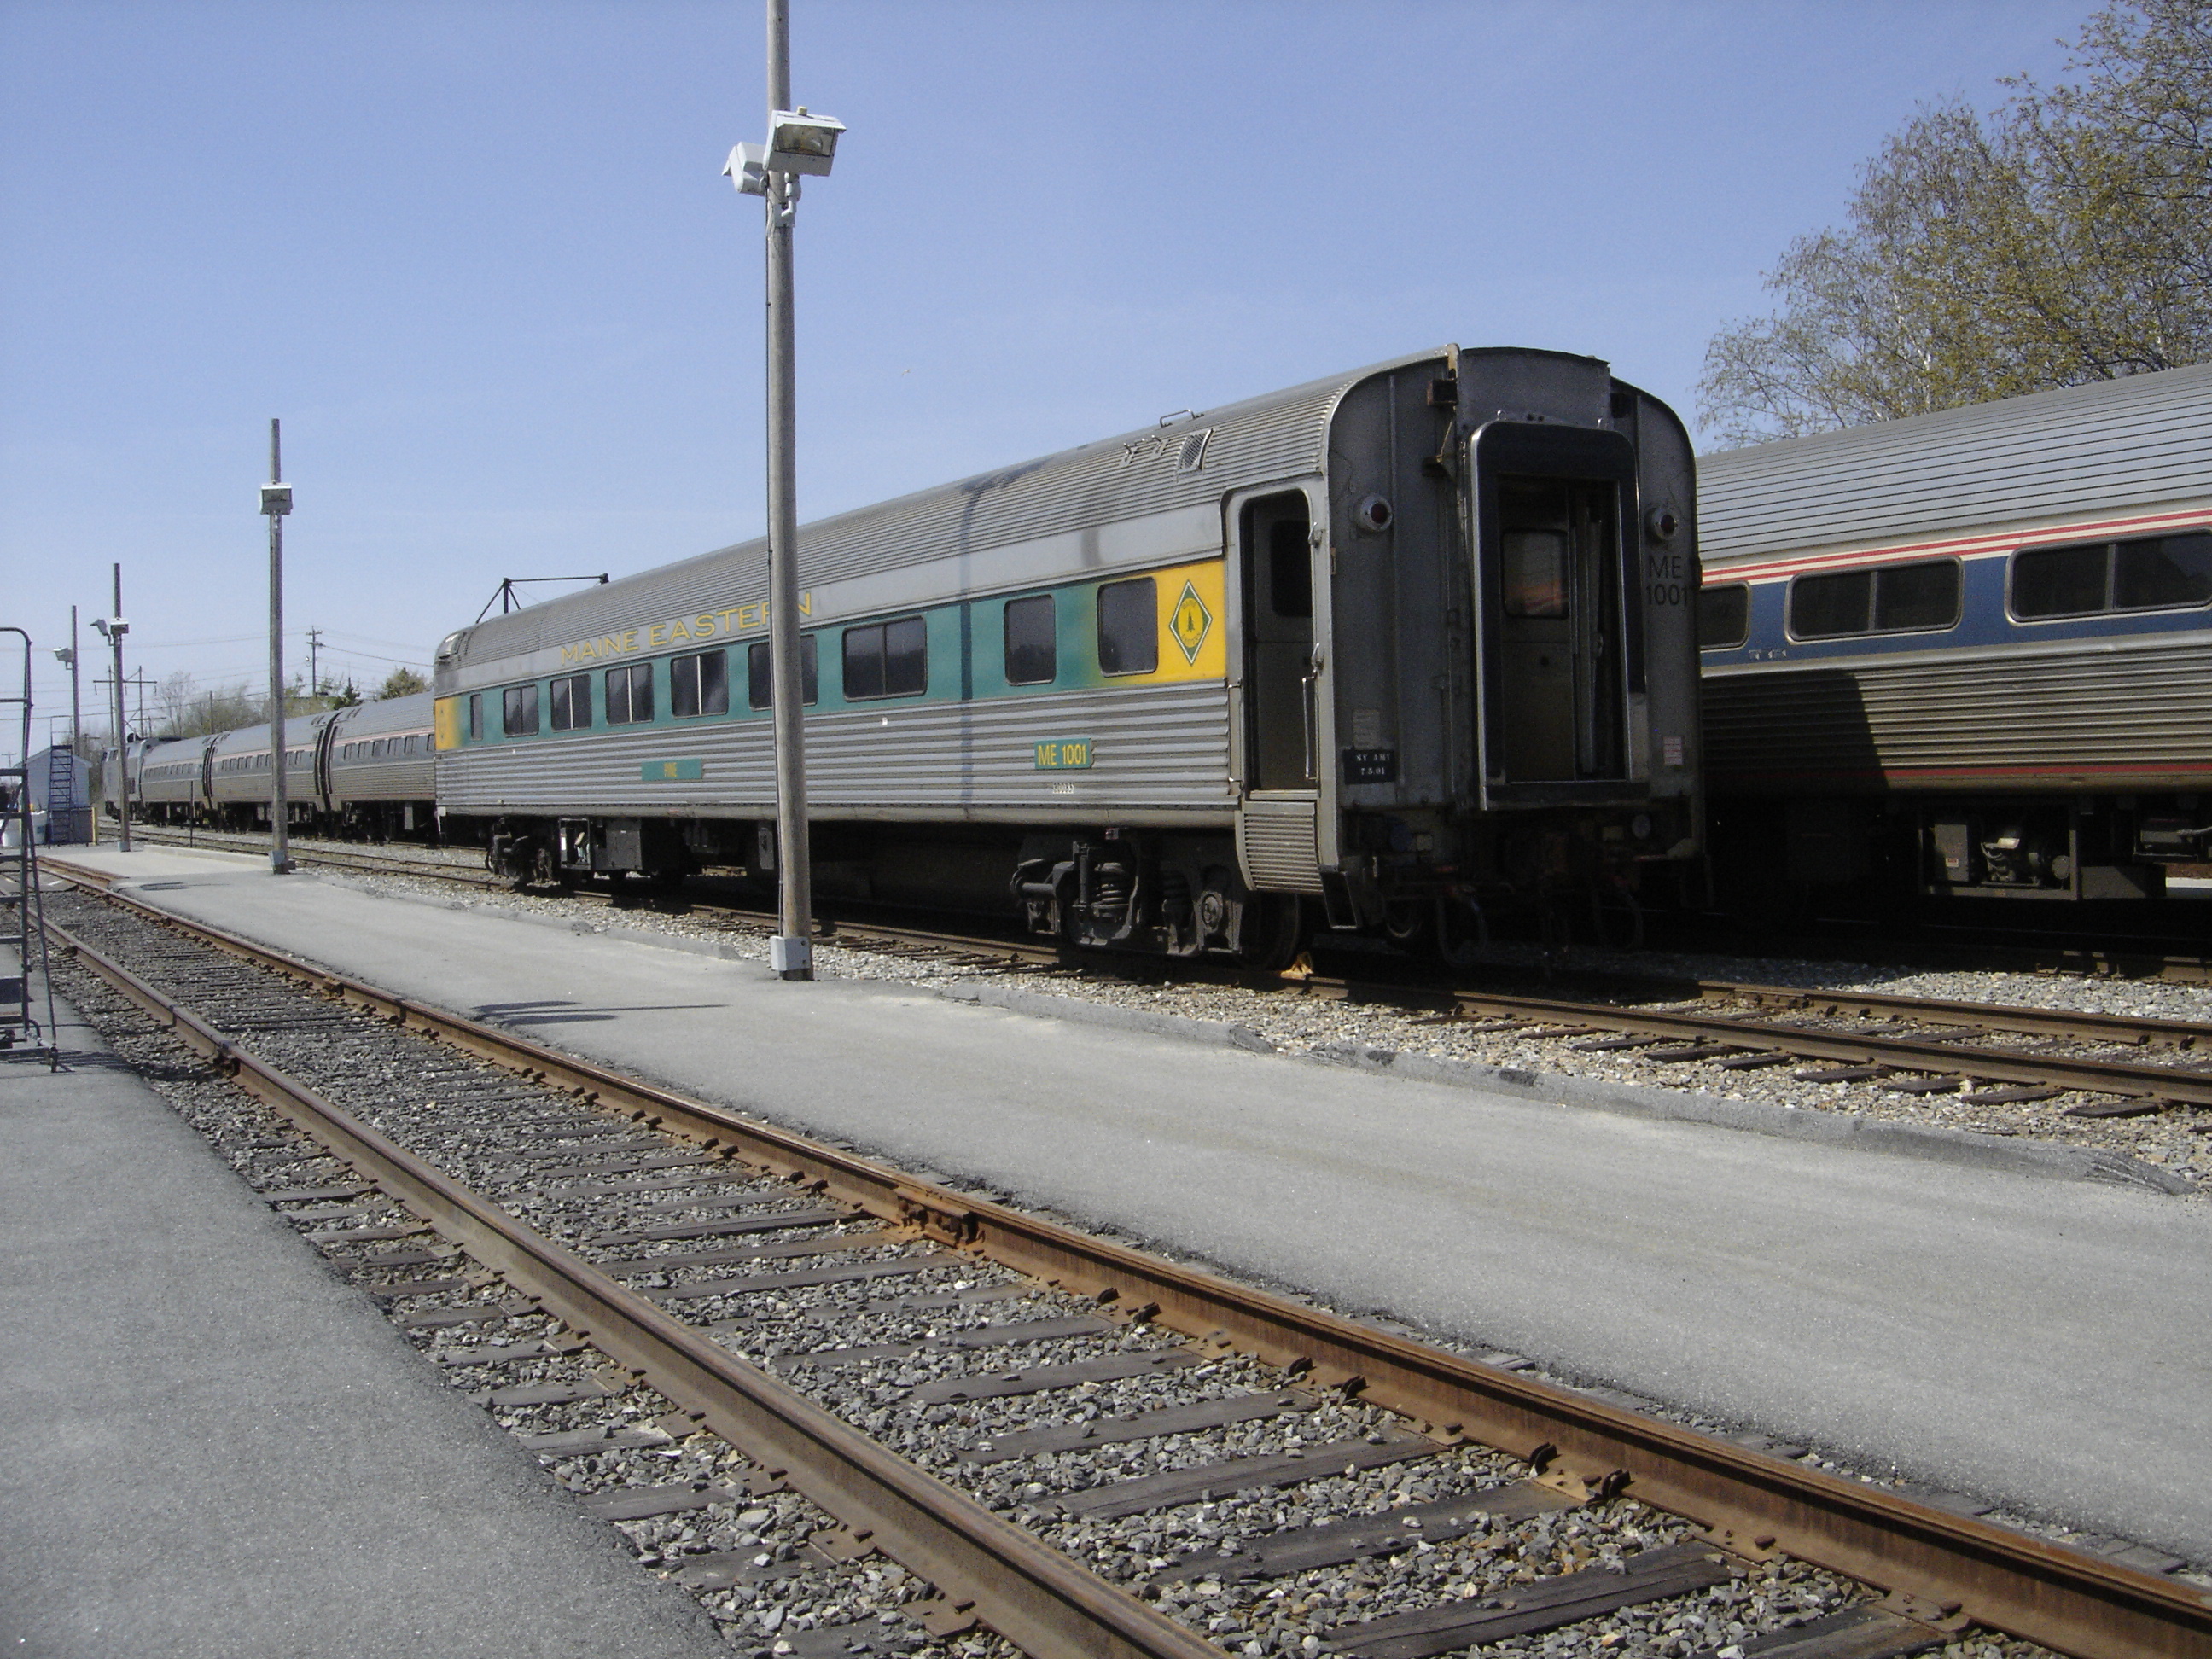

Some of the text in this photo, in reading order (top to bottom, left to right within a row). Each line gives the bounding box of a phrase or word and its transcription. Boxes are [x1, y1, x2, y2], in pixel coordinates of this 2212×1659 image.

[1648, 555, 1682, 579] ME
[1645, 583, 1688, 606] 1001
[560, 630, 639, 666] MAINE
[1037, 743, 1087, 766] ME 1001
